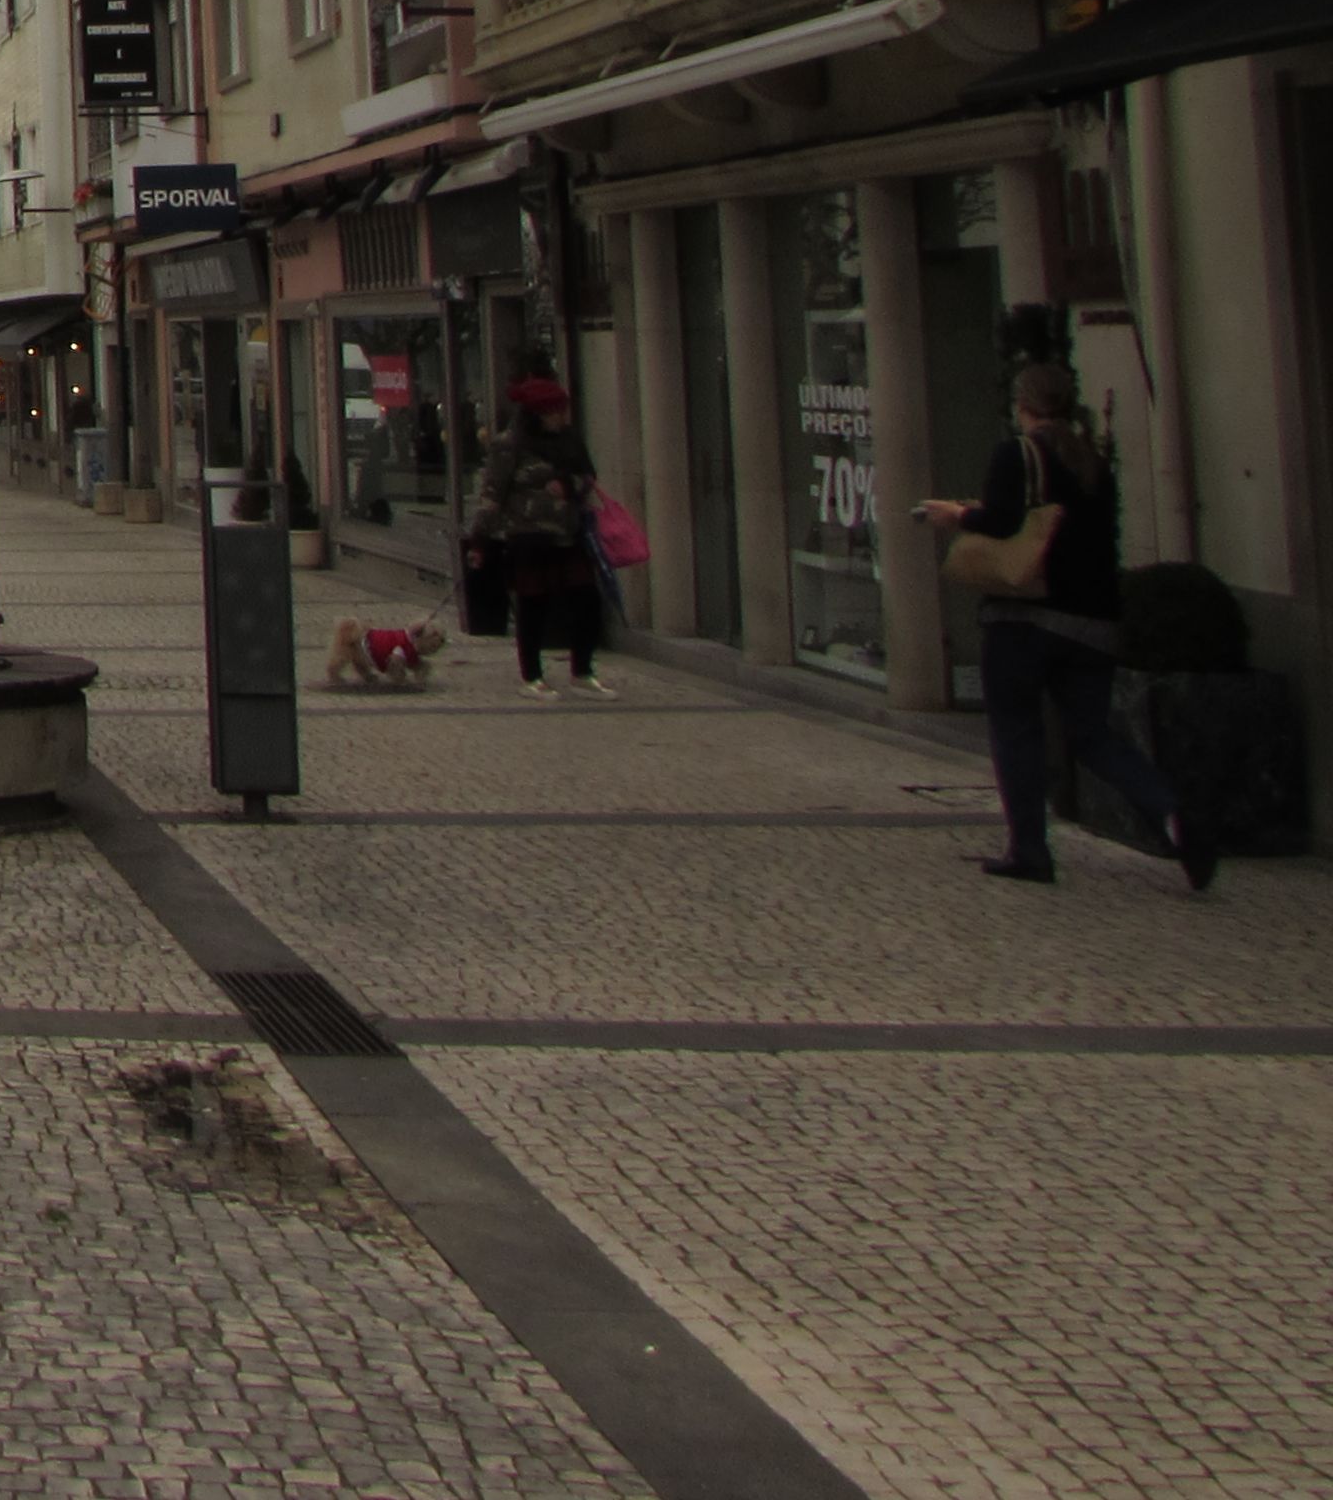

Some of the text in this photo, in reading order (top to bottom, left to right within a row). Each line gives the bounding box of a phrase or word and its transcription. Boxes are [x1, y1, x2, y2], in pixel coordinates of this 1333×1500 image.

[139, 188, 236, 209] SPORVAL
[801, 411, 872, 442] PREÇO
[810, 455, 877, 528] -70%
